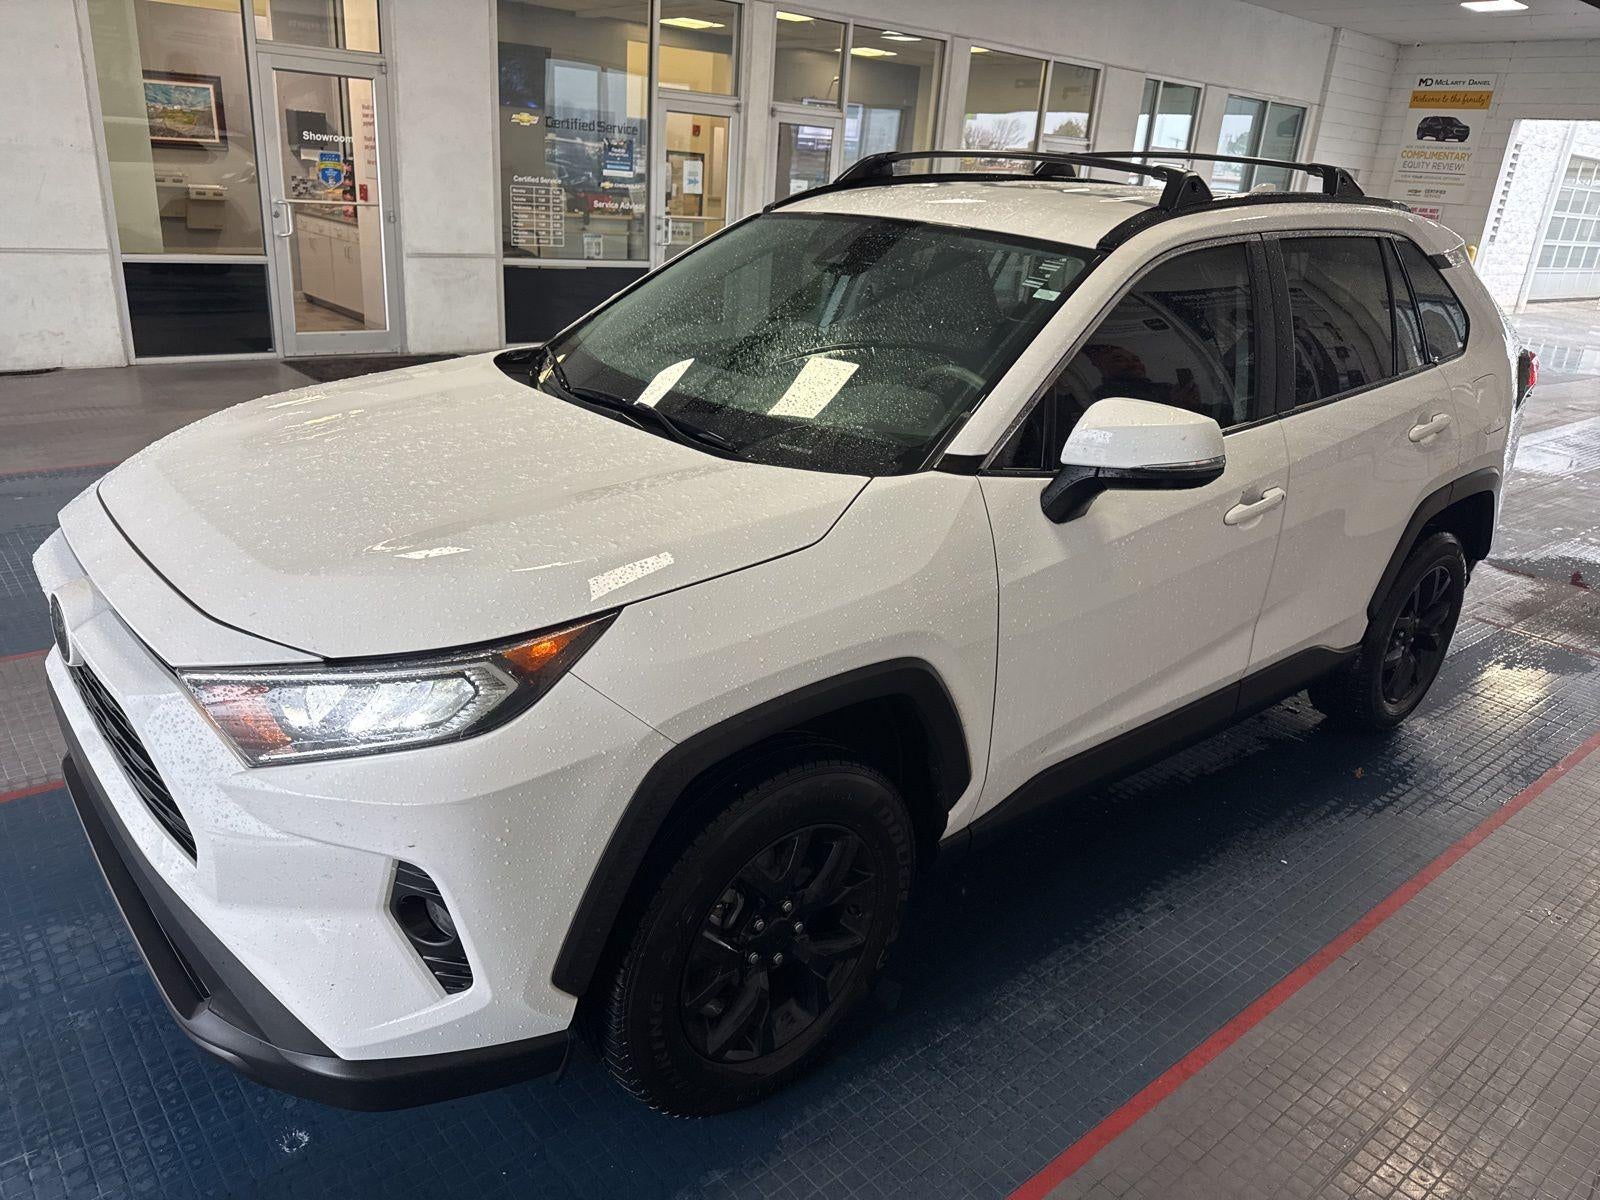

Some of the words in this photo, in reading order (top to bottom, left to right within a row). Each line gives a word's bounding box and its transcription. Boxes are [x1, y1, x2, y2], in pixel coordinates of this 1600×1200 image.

[1418, 78, 1434, 87] MD
[1442, 95, 1450, 103] to
[1450, 94, 1462, 103] the
[545, 116, 596, 133] Certified
[597, 121, 639, 136] Service
[302, 131, 354, 143] Showroom
[1401, 150, 1472, 161] COMPLIMENTARY
[1402, 160, 1431, 169] EQUITY
[1431, 162, 1465, 171] REVIEW!
[513, 175, 540, 183] Certified
[540, 176, 562, 184] Service
[593, 200, 619, 209] Service
